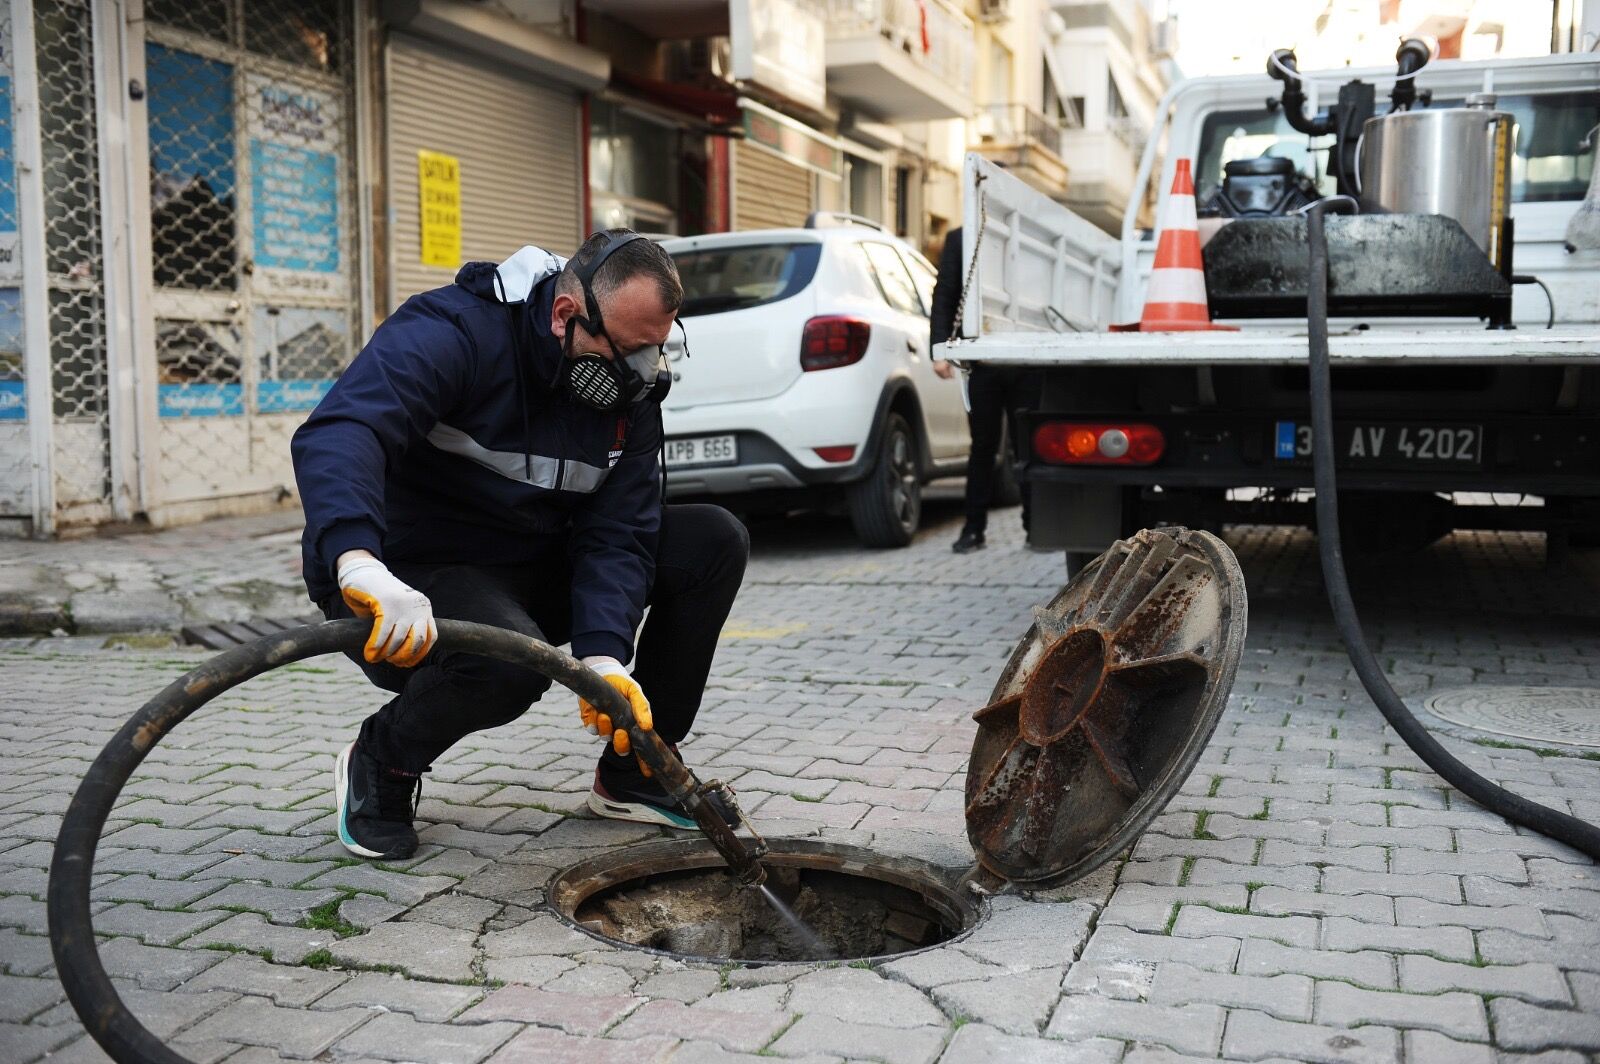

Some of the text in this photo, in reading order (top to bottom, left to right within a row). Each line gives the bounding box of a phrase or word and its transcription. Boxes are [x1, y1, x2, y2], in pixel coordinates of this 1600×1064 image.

[667, 438, 732, 460] APB 666
[1349, 427, 1385, 457] AV
[1398, 428, 1475, 459] 4202
